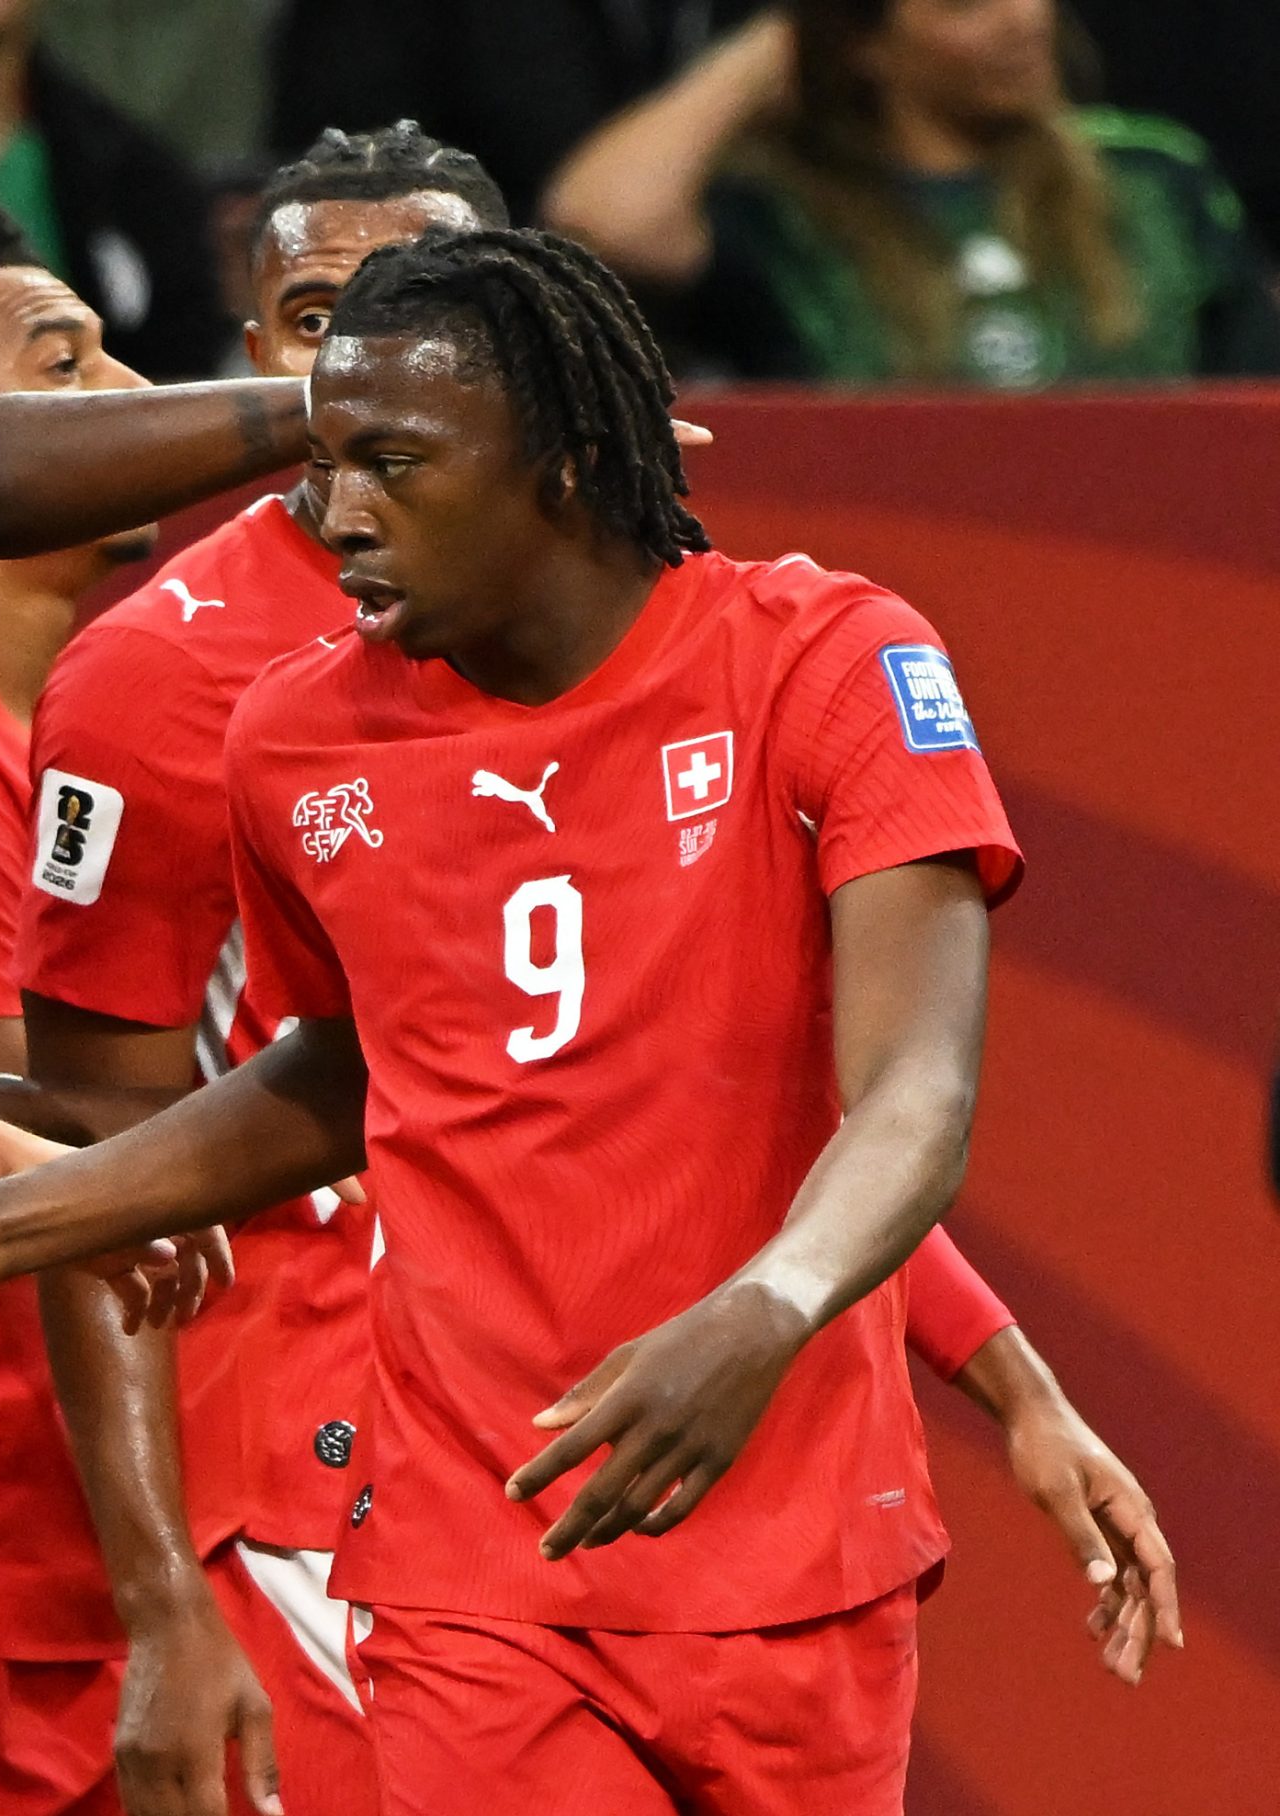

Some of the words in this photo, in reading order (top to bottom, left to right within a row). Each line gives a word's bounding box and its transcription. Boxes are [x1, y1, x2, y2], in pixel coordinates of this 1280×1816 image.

[912, 701, 937, 720] the
[42, 869, 76, 890] 2026
[503, 874, 585, 1064] 9
